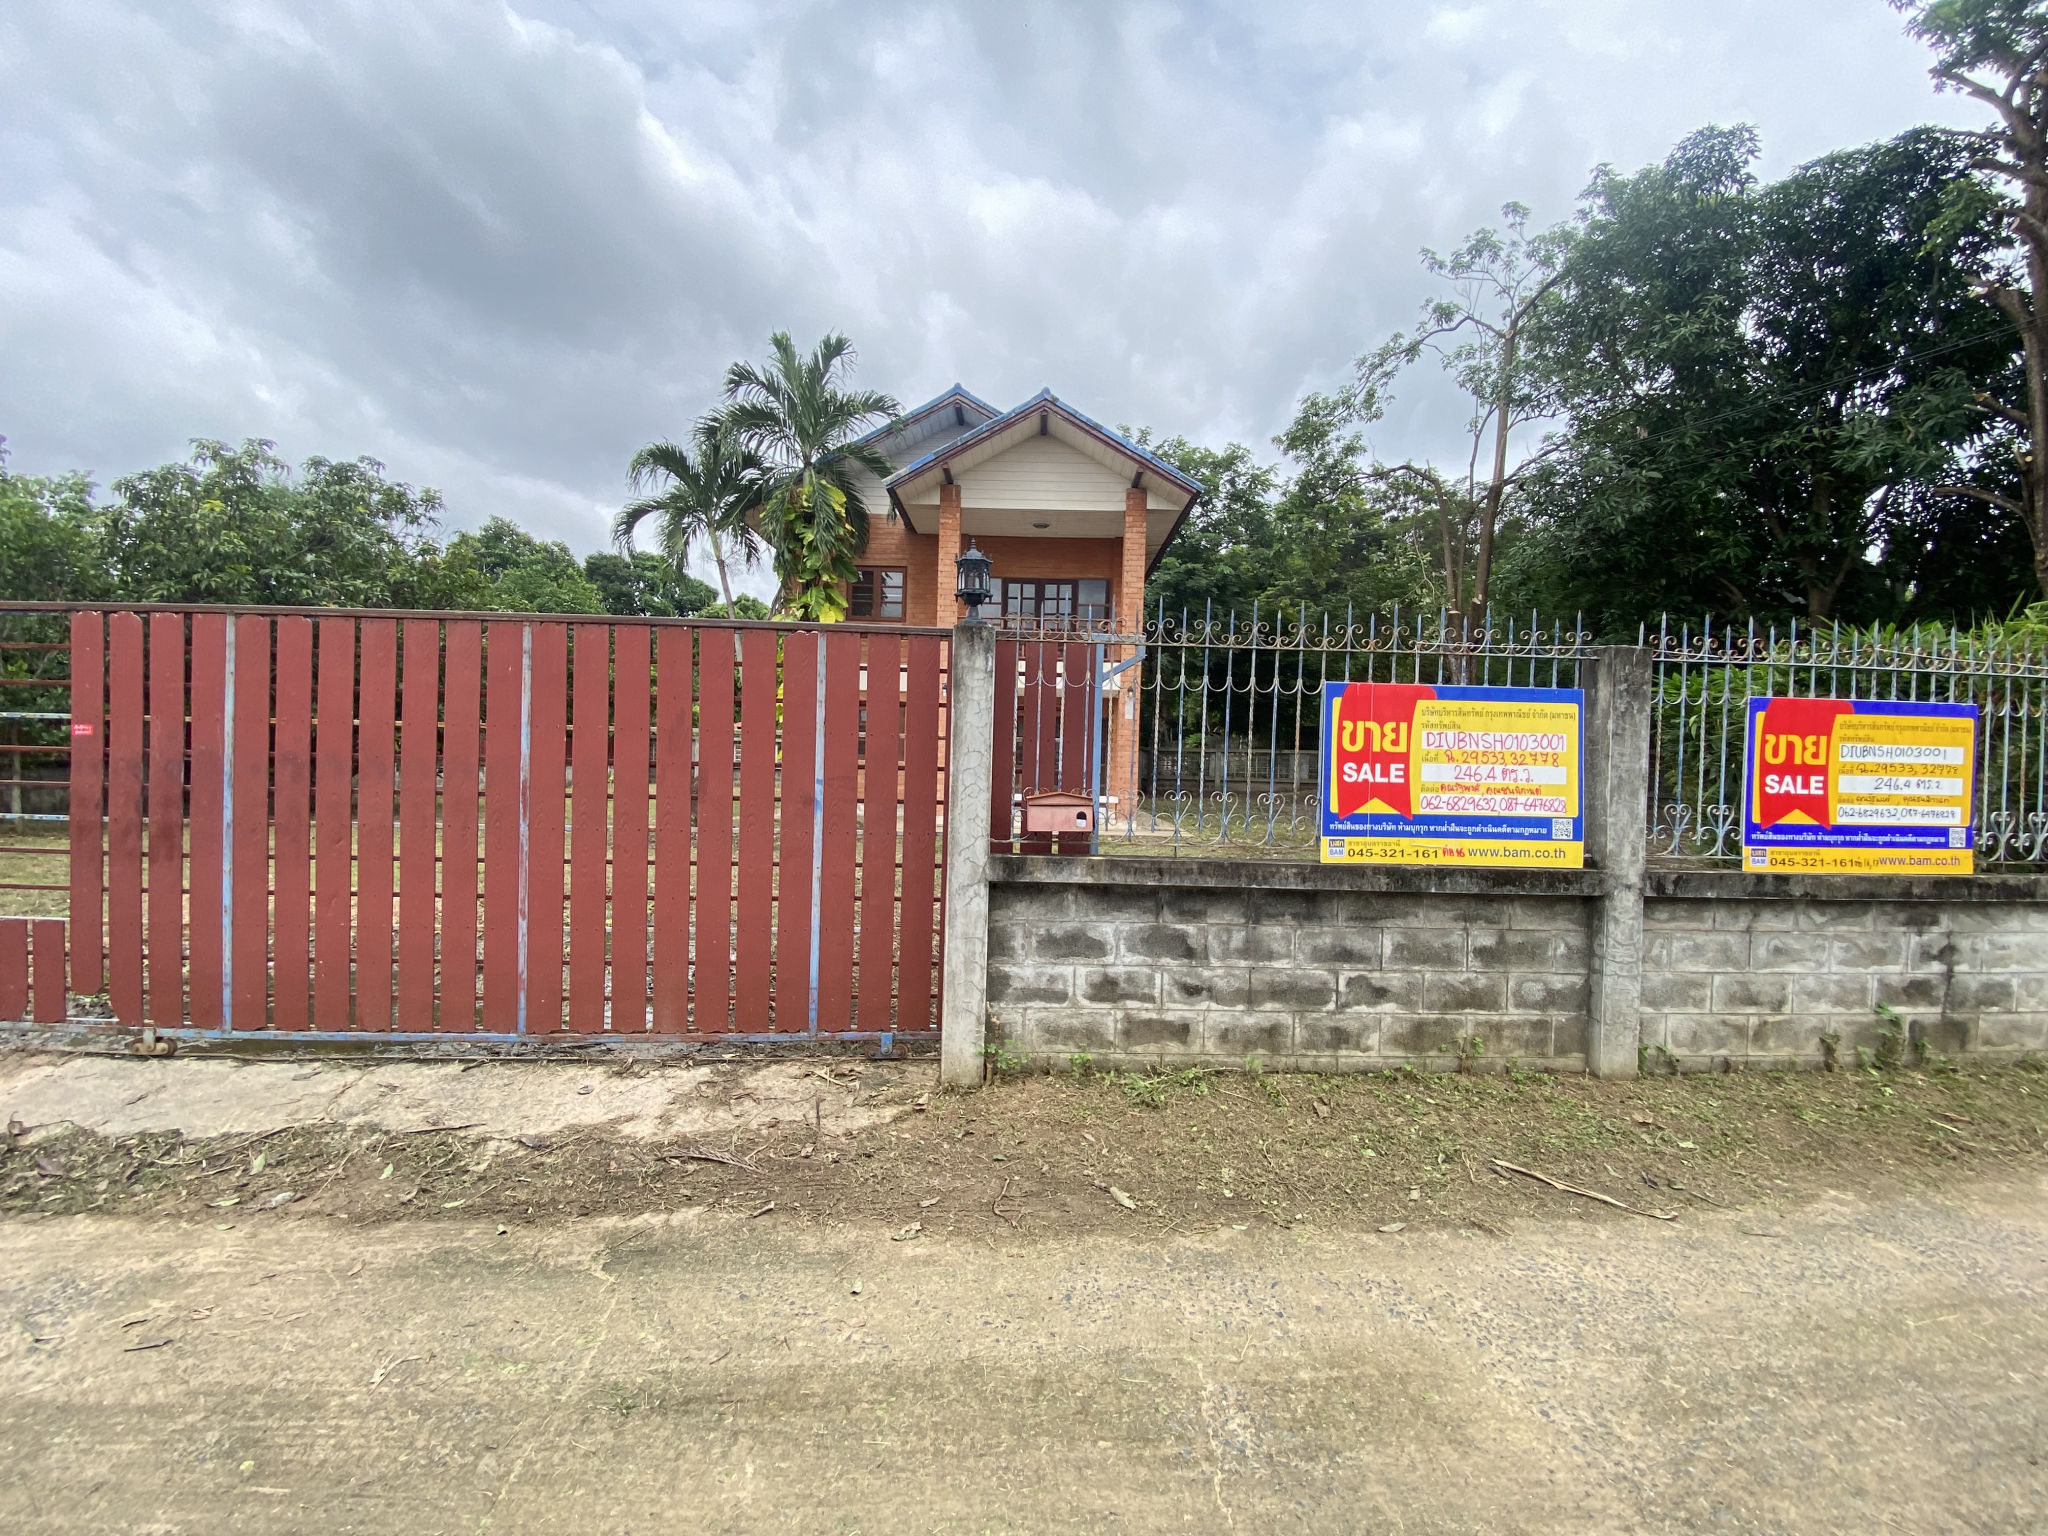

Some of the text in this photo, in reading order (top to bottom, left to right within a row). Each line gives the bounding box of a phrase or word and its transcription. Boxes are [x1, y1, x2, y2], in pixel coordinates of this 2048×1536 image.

[1342, 720, 1408, 753] ขาย
[1765, 733, 1828, 765] ขาย
[1342, 762, 1405, 783] SALE
[1454, 765, 1497, 782] 246.4
[1765, 774, 1824, 795] SALE
[1874, 777, 1911, 790] 246.4
[1329, 848, 1344, 856] BAM
[1348, 848, 1439, 859] 045-321-161
[1468, 847, 1566, 859] www.bam.co.th
[1770, 857, 1854, 867] 045-321-161
[1879, 855, 1961, 866] www.bam.co.th
